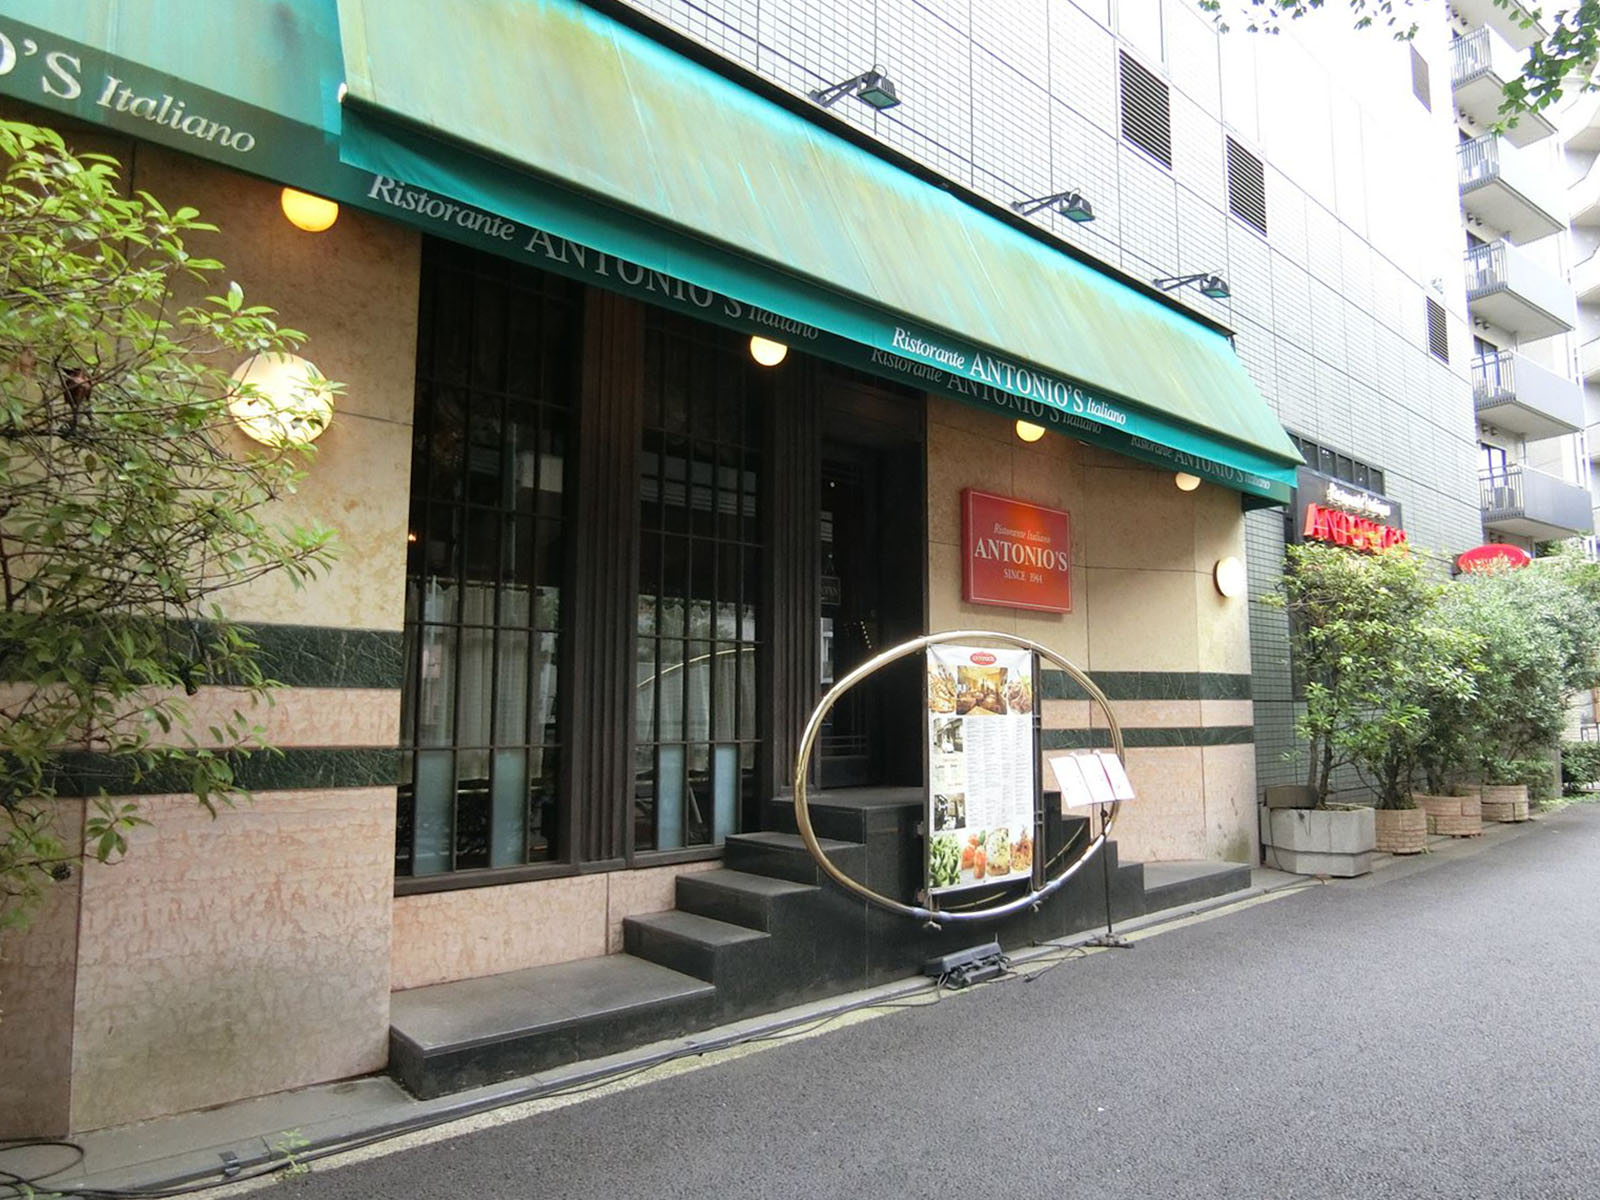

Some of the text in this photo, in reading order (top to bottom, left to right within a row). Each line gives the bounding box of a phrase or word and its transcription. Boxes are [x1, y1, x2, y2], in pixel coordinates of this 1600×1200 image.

[96, 75, 256, 152] Italiano
[367, 174, 516, 241] Ristorante
[892, 326, 1127, 425] Ristorante ANTONIO'S Italiano
[974, 537, 1067, 572] ANTONIO'S
[1004, 568, 1026, 581] SINCE
